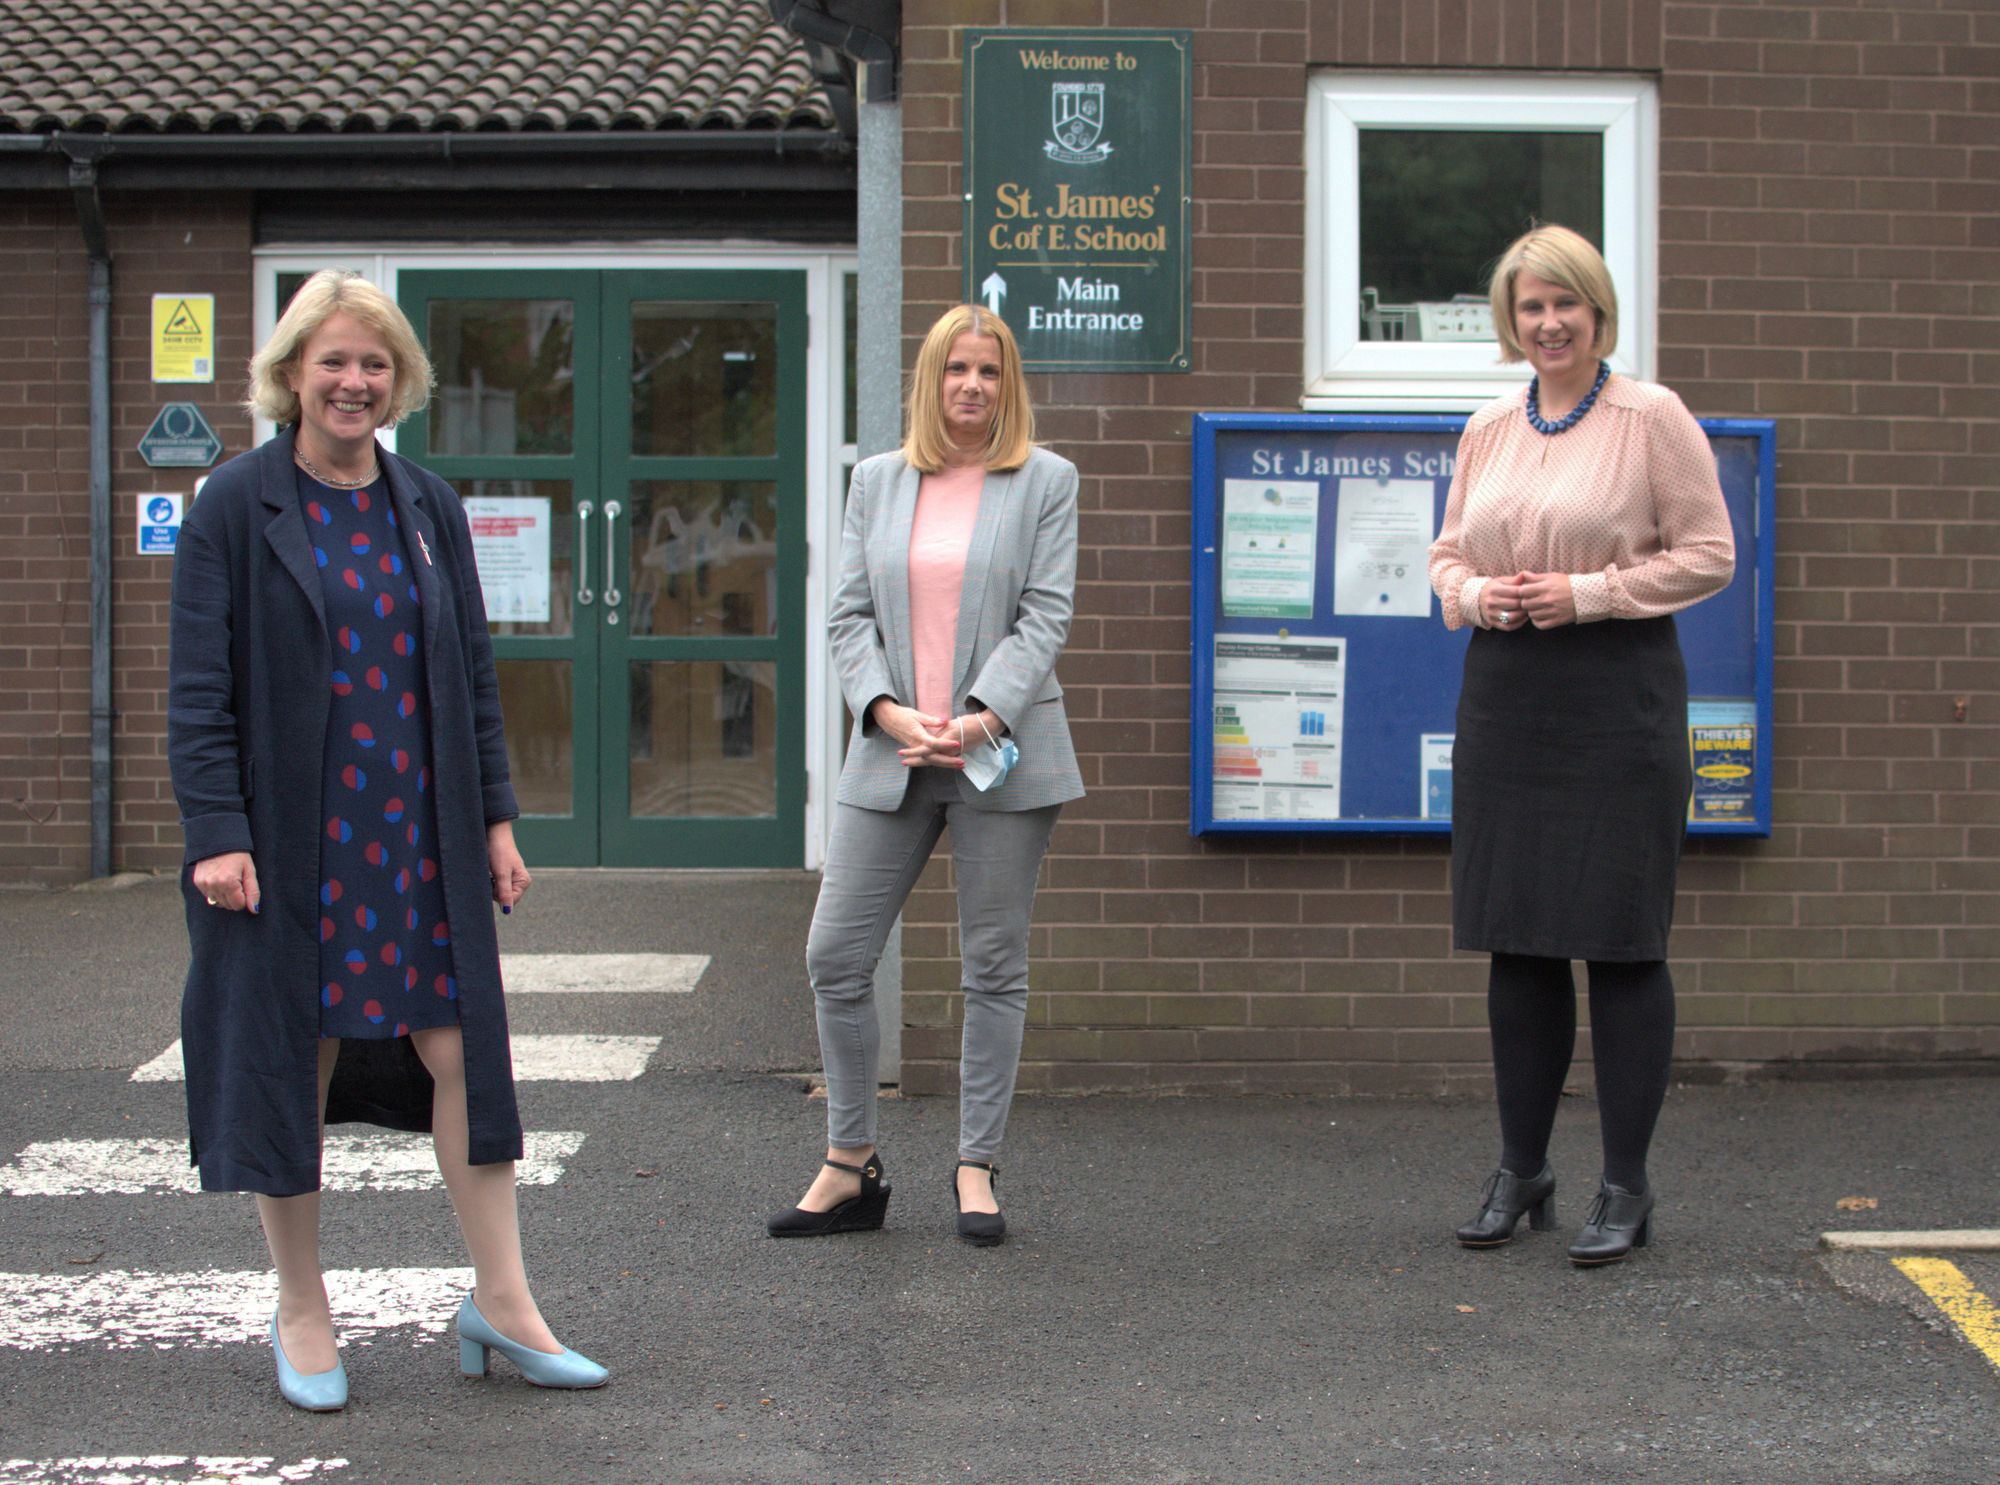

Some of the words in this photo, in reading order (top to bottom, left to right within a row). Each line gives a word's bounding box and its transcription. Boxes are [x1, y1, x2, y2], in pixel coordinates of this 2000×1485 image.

[1019, 50, 1110, 71] Welcome
[1116, 52, 1137, 71] to
[995, 182, 1039, 219] St.
[1046, 183, 1161, 219] James'
[989, 223, 1013, 250] C.
[1014, 223, 1043, 250] of
[1048, 224, 1071, 250] E.
[1074, 224, 1167, 251] School
[1057, 276, 1120, 301] Main
[1028, 306, 1144, 331] Entrance
[1252, 449, 1285, 475] St
[1294, 450, 1391, 476] James
[1695, 729, 1752, 740] THIEVES
[1695, 739, 1751, 751] BEWARE
